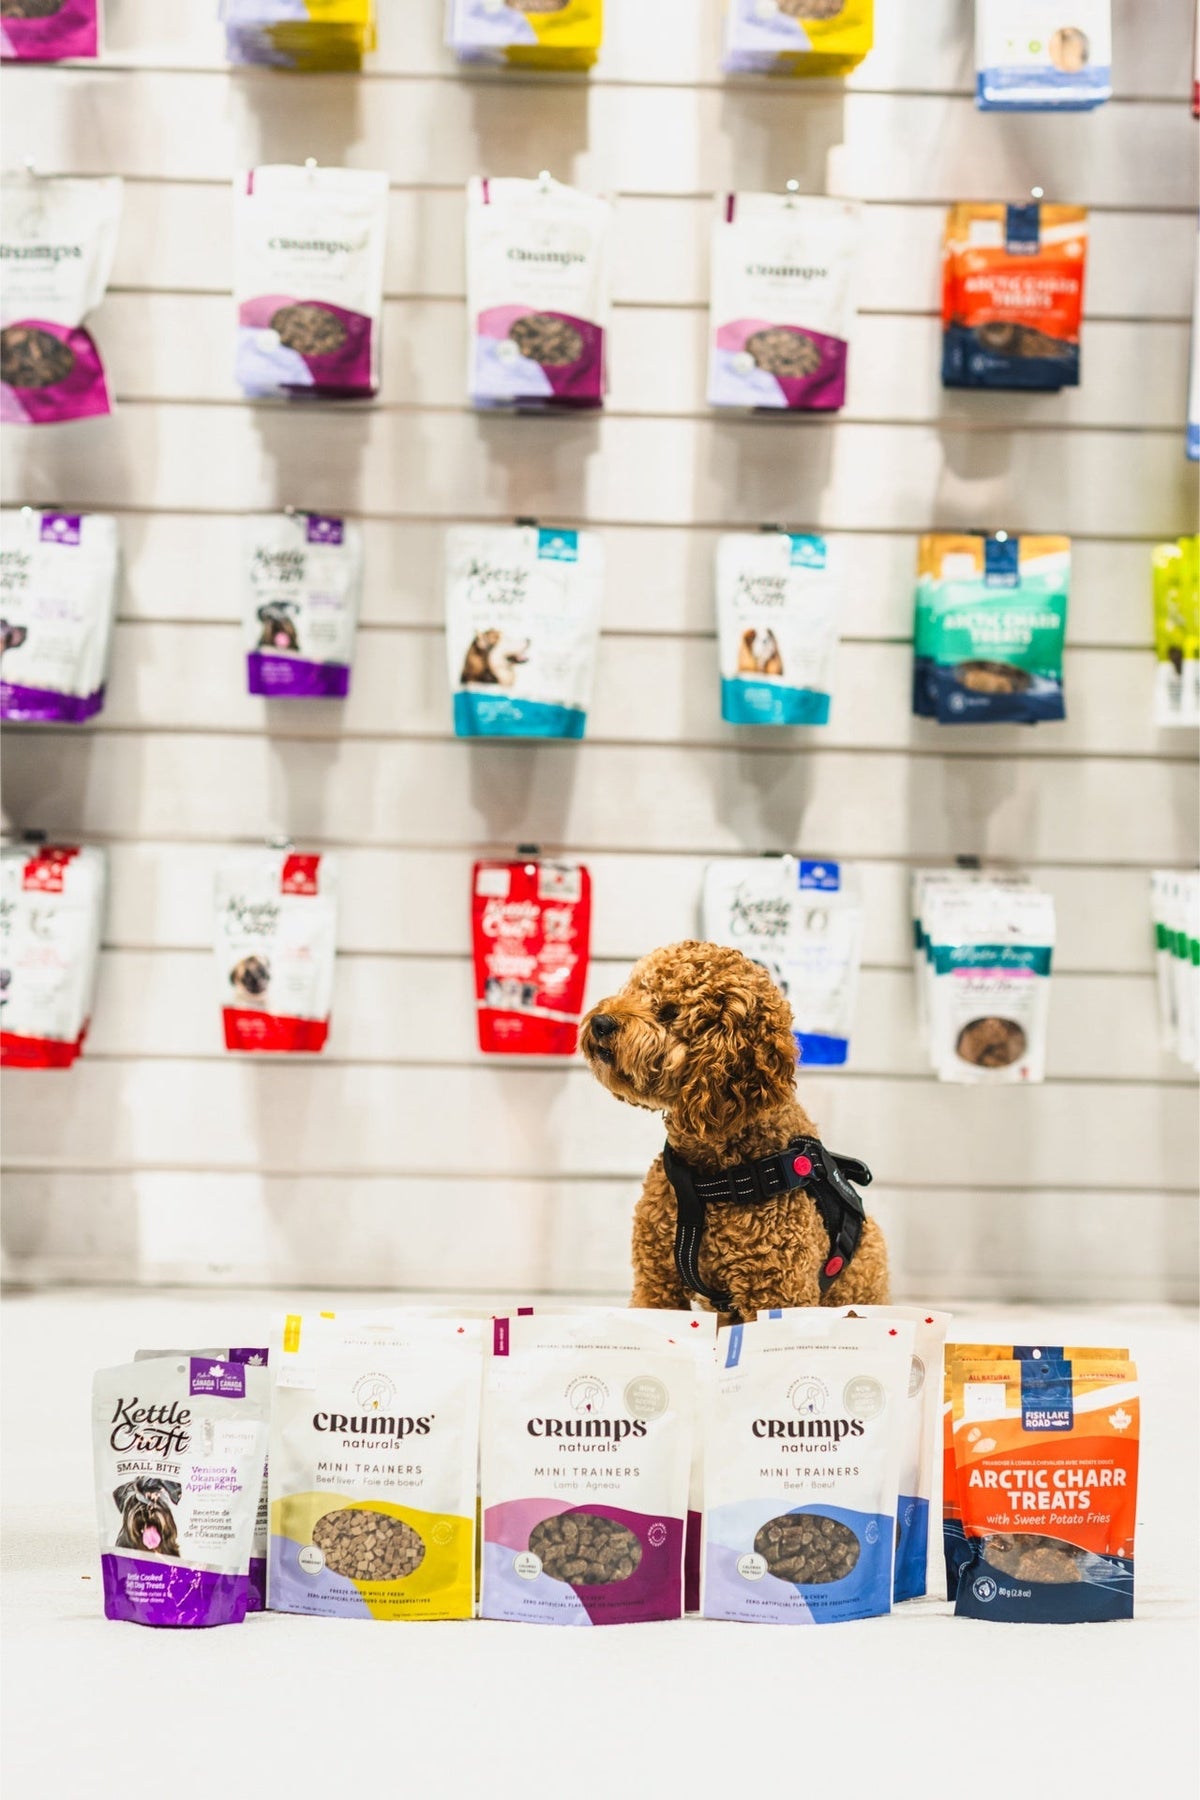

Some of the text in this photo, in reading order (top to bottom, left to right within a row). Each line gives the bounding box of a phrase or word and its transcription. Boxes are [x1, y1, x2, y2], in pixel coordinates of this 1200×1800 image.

[943, 613, 1001, 629] ARCTIC
[970, 629, 1032, 644] TREATS
[111, 1397, 191, 1425] Kettle
[1025, 1411, 1070, 1420] FISH LAKE
[1025, 1419, 1051, 1427] ROAD
[110, 1422, 190, 1457] Craft
[343, 1439, 401, 1450] naturals
[559, 1441, 618, 1452] naturals
[781, 1441, 838, 1453] naturals
[117, 1462, 181, 1474] SMALL BITE
[192, 1466, 237, 1474] Venison &
[318, 1462, 422, 1474] MINI TRAINERS
[534, 1467, 640, 1477] MINI TRAINERS
[760, 1467, 859, 1477] MINI TRAINERS
[191, 1475, 237, 1484] Okanagan
[316, 1475, 424, 1487] Beef liver Foie de boeuf
[968, 1468, 1127, 1488] ARCTIC CHARR
[185, 1483, 243, 1493] Apple Recipe
[554, 1481, 621, 1491] Lamb Agneau
[784, 1481, 835, 1489] Beef Boeuf
[1007, 1490, 1090, 1510] TREATS
[986, 1512, 1111, 1525] with Sweet Potato Fries
[321, 1594, 350, 1602] ARTIFICIAL
[538, 1600, 568, 1608] ARTIFICIAL
